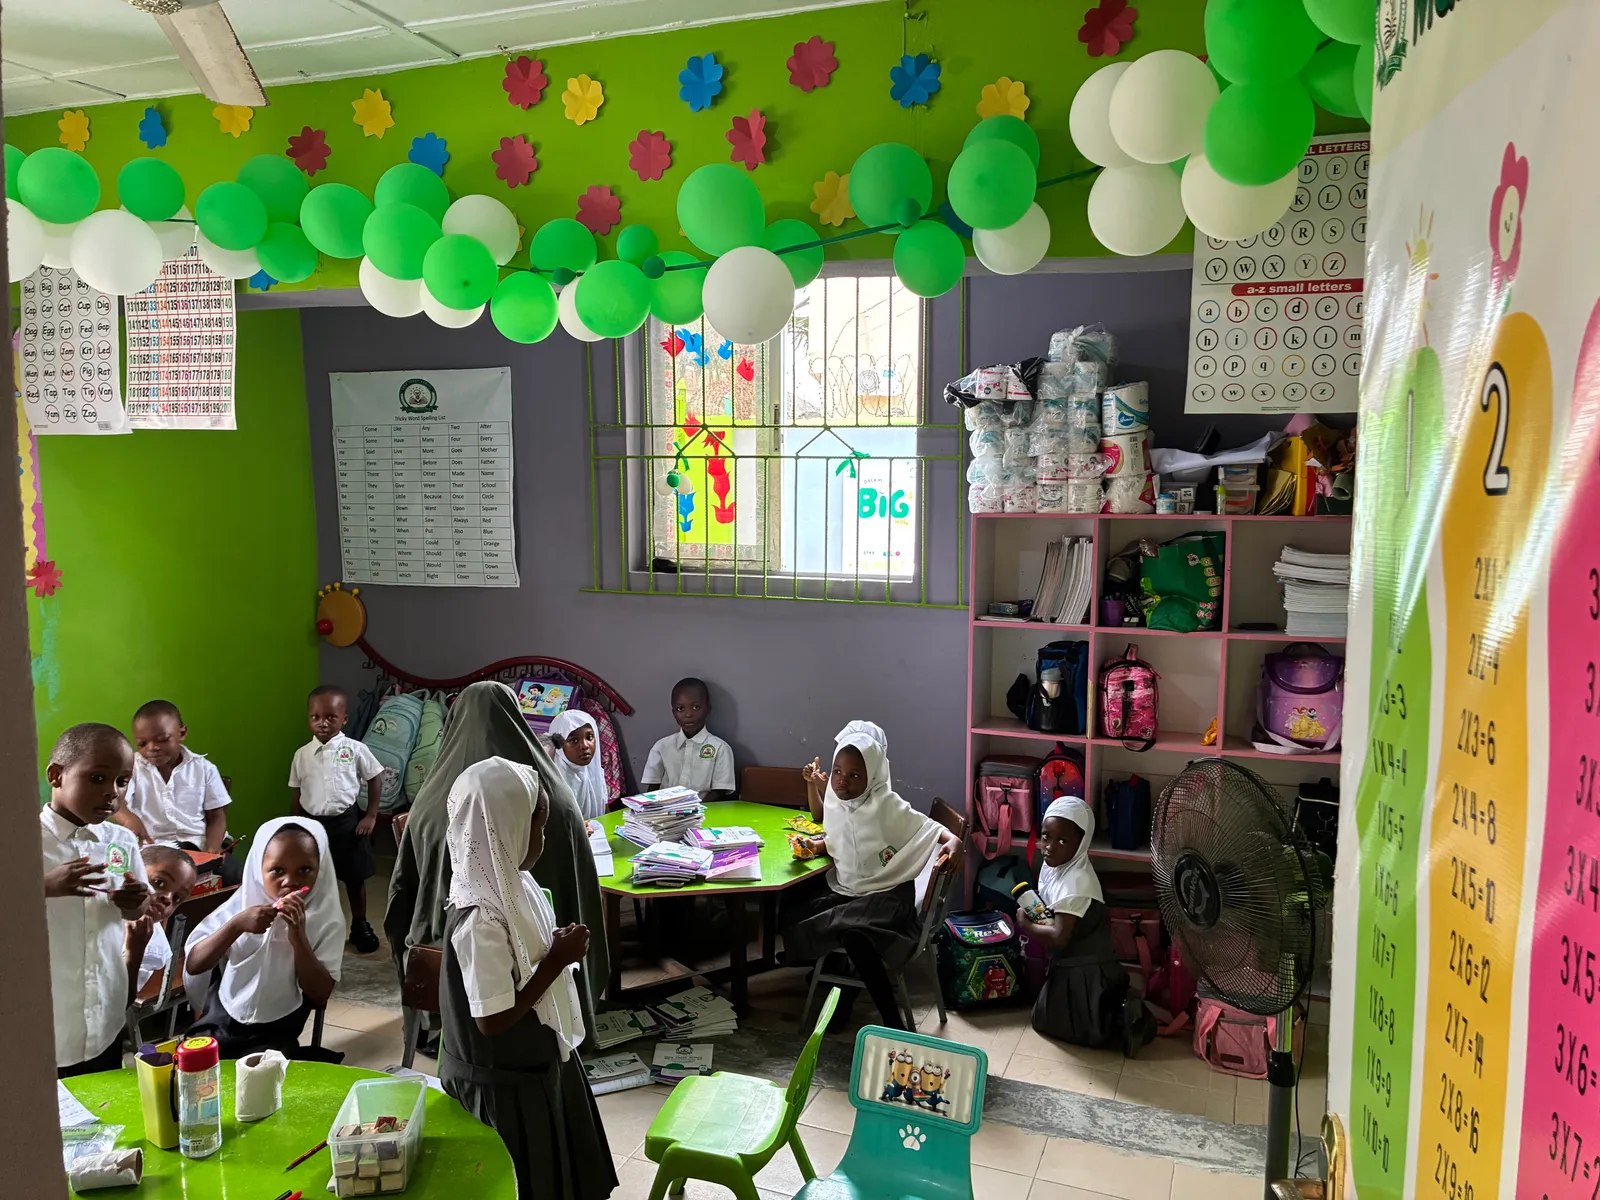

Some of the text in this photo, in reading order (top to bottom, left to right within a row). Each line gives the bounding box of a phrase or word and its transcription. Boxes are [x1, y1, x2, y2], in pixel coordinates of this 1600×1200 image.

[1319, 142, 1369, 153] LETTERS
[1304, 165, 1312, 176] D
[1333, 164, 1341, 175] E
[1294, 189, 1367, 205] K L M
[1268, 227, 1279, 240] Q
[1299, 227, 1308, 238] R
[1329, 225, 1337, 237] S
[1212, 259, 1339, 275] V W X Y Z
[41, 283, 52, 293] Big
[58, 283, 71, 291] Box
[1247, 282, 1352, 294] a-z small letters
[24, 300, 110, 316] Cap Car Cat Cup Dig
[1205, 300, 1363, 318] a b c d e f
[24, 327, 38, 337] Dog
[42, 325, 55, 337] Egg
[80, 325, 92, 333] Fed
[97, 323, 110, 332] Gap
[1204, 335, 1211, 346] h
[1234, 334, 1239, 346] i
[1262, 332, 1269, 346] j
[1291, 333, 1300, 345] k
[1350, 333, 1361, 341] m
[60, 347, 74, 355] Jam
[81, 346, 92, 355] Kit
[82, 366, 92, 377] Pig
[98, 367, 111, 376] Rat
[1202, 360, 1357, 372] o p q r s t
[82, 387, 95, 398] Tip
[98, 387, 113, 396] Van
[1290, 388, 1298, 397] y
[1319, 388, 1327, 396] z
[45, 409, 96, 420] Yam Zip Zoo
[1480, 361, 1510, 496] 2
[1457, 708, 1497, 765] 2X3=6
[1452, 783, 1497, 845] 2X4=8
[1372, 923, 1396, 979] 1X7=7
[1450, 929, 1491, 1004] 2X6=12
[1369, 984, 1395, 1045] 1X8=8
[1366, 1045, 1392, 1108] 1X9=9
[1440, 1072, 1480, 1154] 2X8=16
